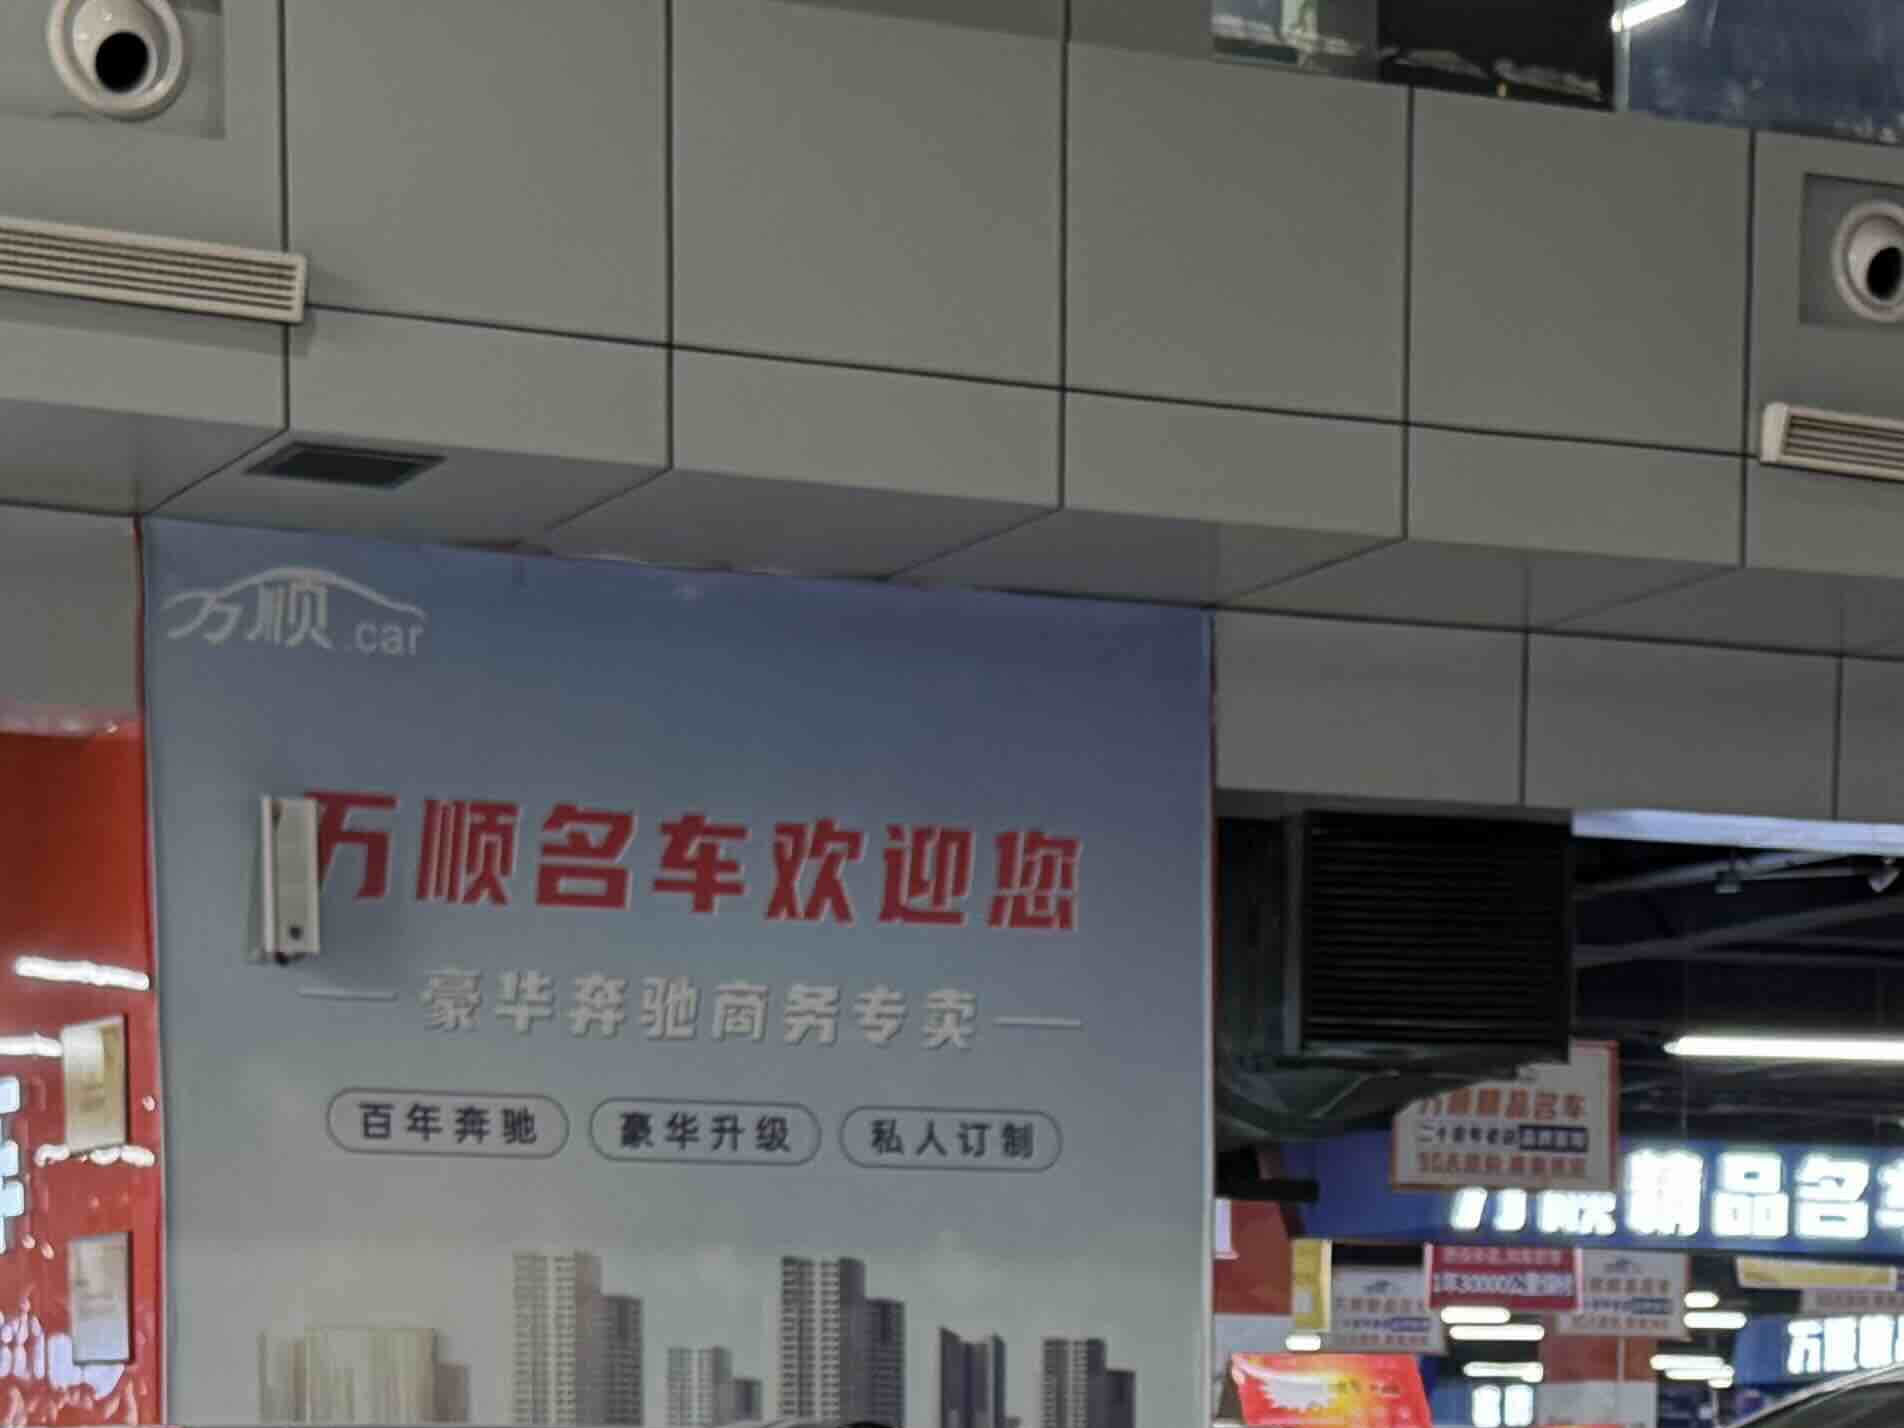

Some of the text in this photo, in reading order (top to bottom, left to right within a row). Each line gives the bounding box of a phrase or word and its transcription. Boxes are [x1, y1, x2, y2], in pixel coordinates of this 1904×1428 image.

[296, 789, 1083, 932] 万顺名车欢迎您
[420, 966, 980, 1051] 豪华奔驰商务专卖
[356, 1099, 540, 1148] 百年奔驰
[617, 1110, 793, 1155] 豪华升级
[869, 1119, 1036, 1162] 私人订制
